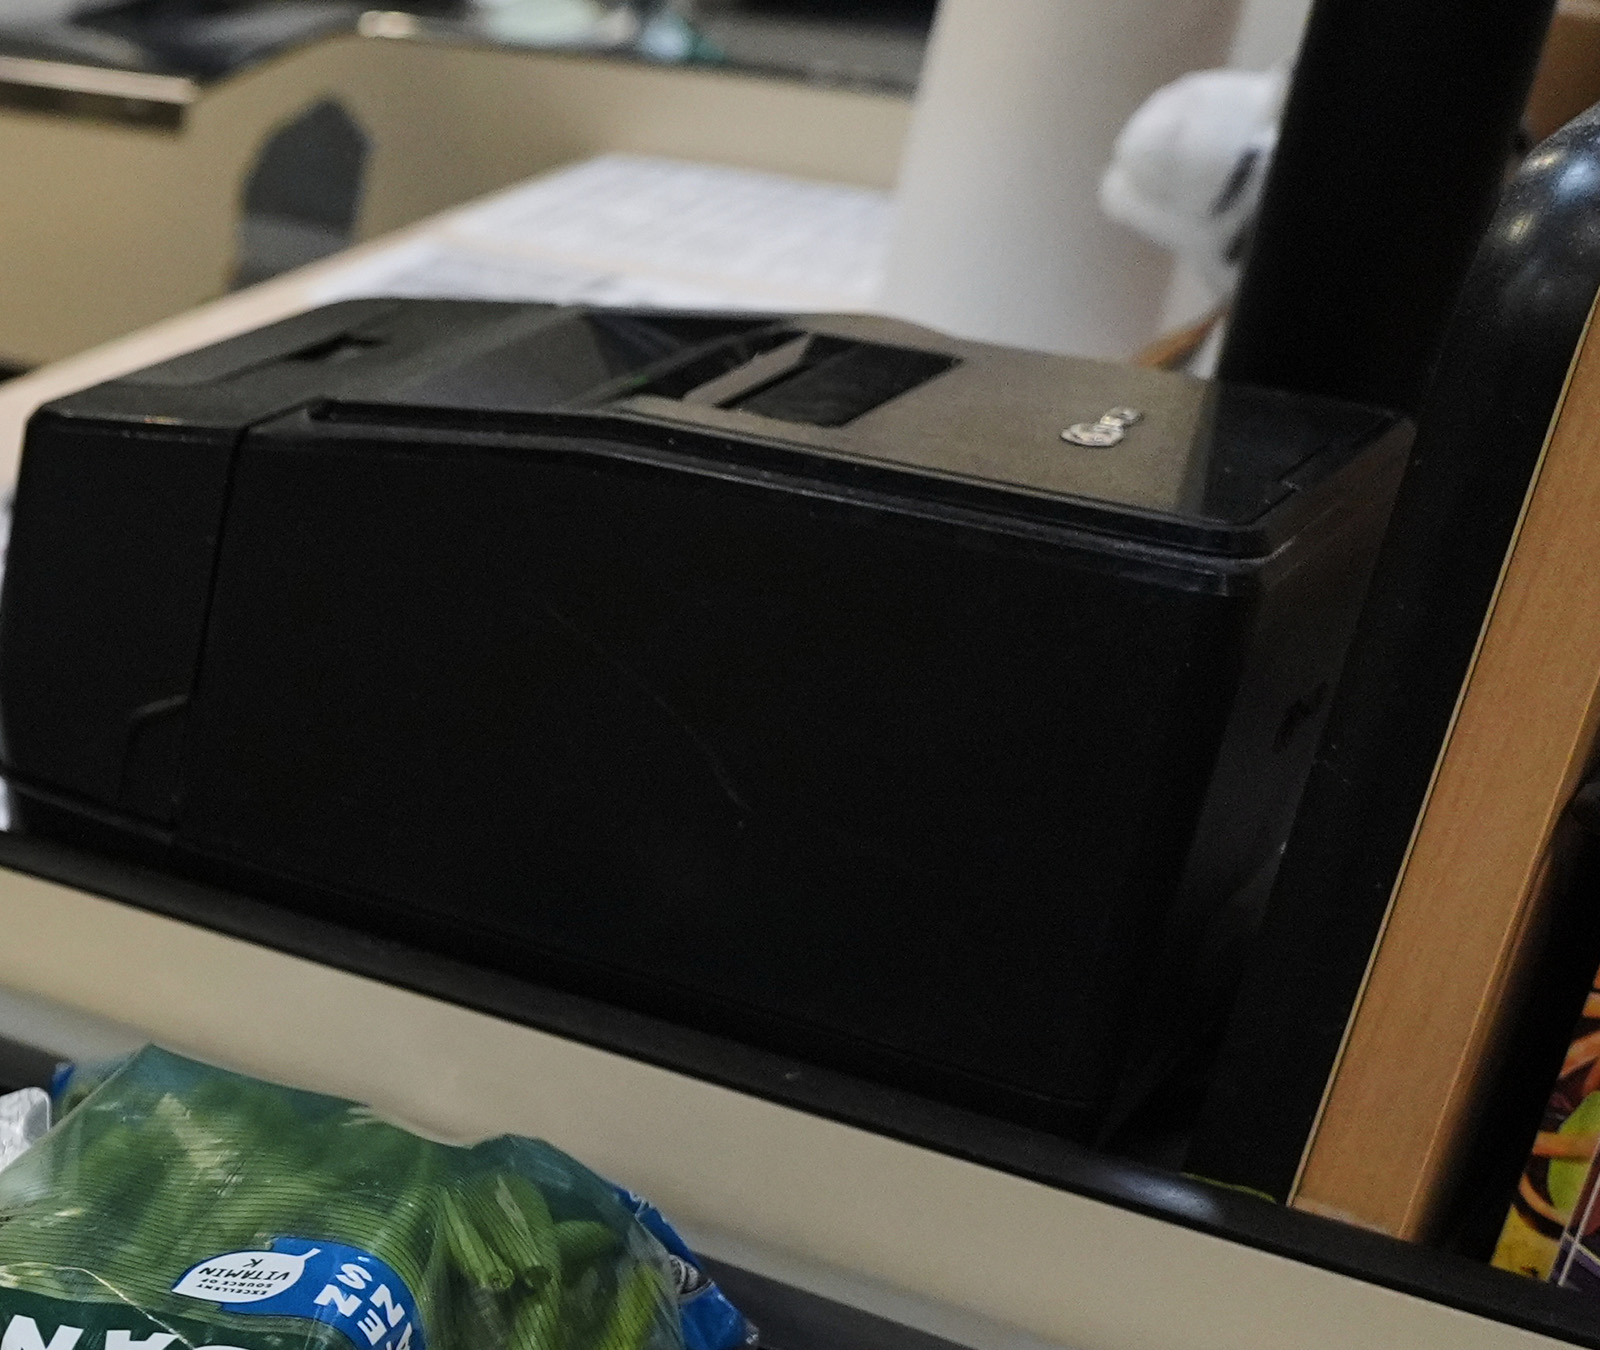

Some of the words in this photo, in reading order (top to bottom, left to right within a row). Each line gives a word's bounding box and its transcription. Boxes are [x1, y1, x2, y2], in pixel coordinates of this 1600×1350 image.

[243, 1259, 264, 1267] K
[199, 1267, 290, 1280] VITAMIN
[222, 1280, 273, 1288] SOURCE
[196, 1284, 268, 1295] EXCELLENT
